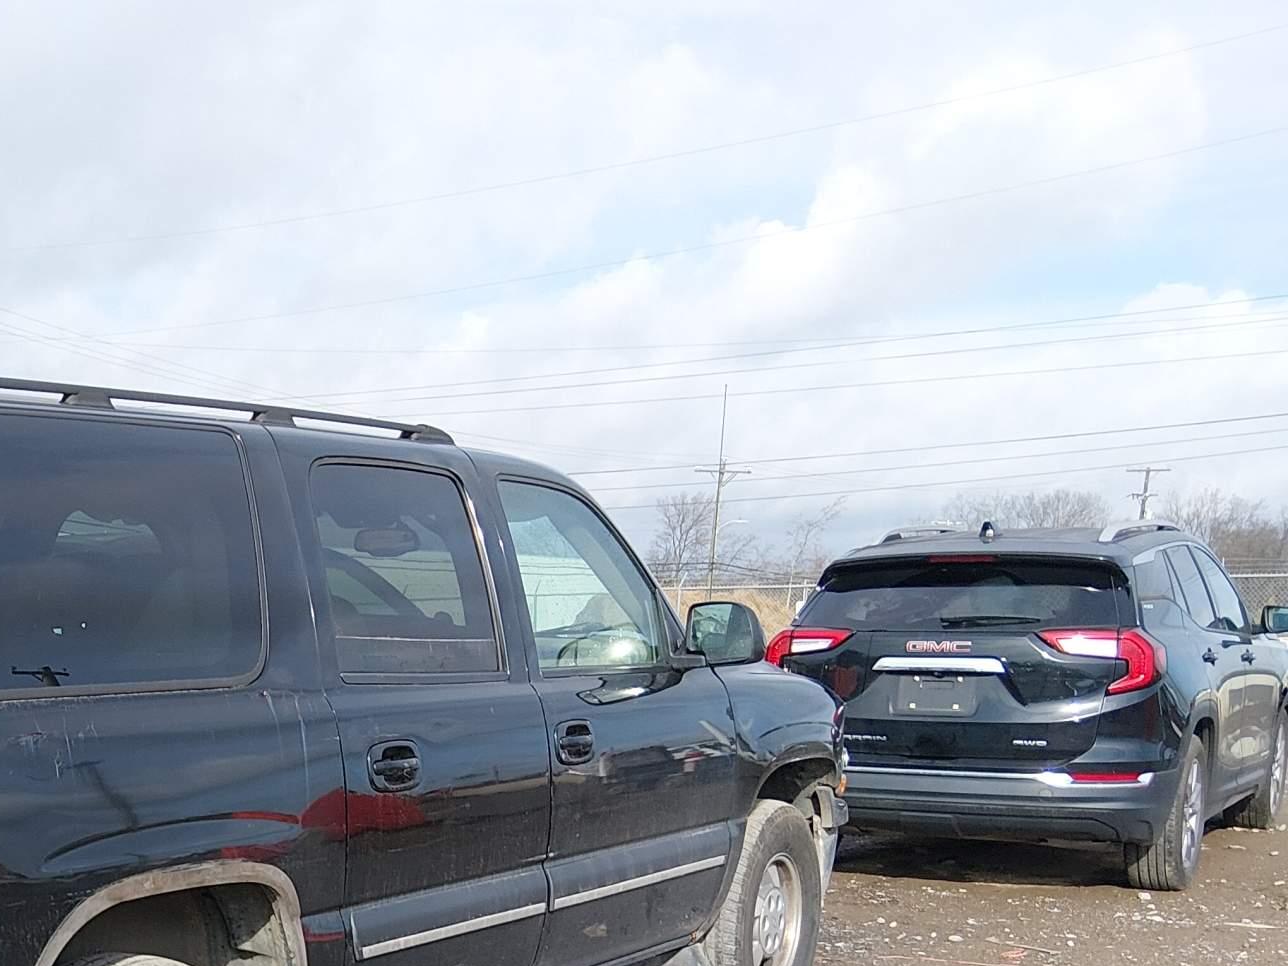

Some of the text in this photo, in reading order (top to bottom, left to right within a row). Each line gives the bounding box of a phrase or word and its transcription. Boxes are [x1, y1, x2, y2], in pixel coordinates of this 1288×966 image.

[906, 640, 972, 653] GMC
[842, 734, 887, 742] RRAIN
[1012, 739, 1048, 747] AWD
